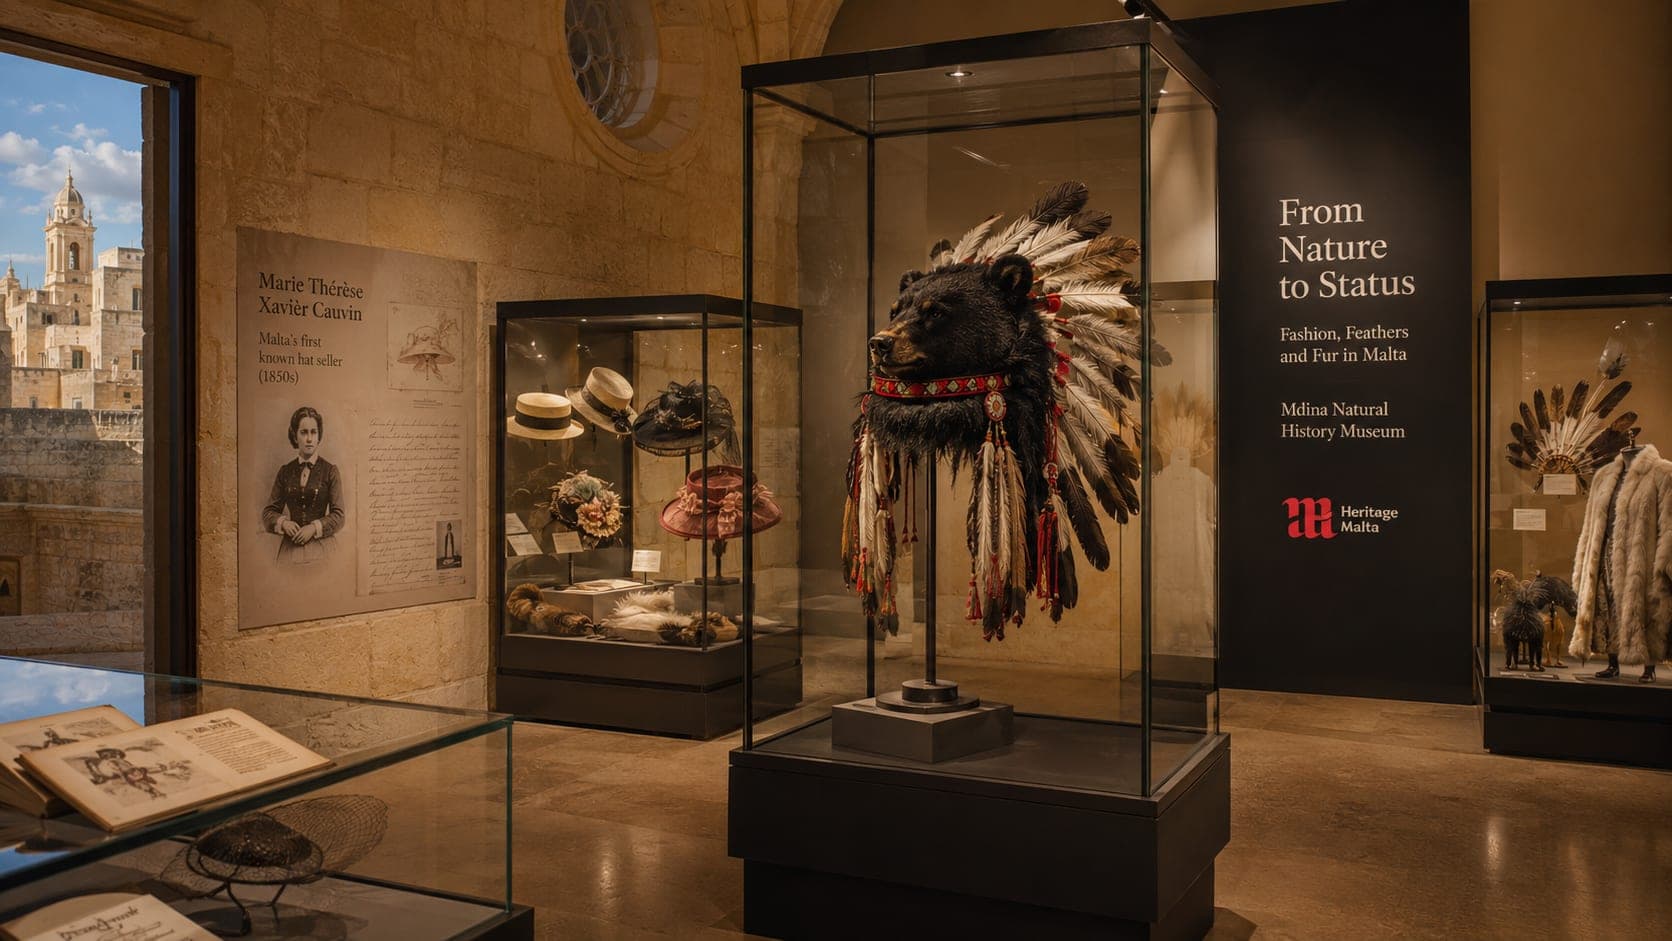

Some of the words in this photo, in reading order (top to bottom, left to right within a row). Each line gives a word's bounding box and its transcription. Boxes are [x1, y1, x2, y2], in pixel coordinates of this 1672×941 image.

[1279, 198, 1364, 226] From
[1279, 235, 1388, 263] Nature
[258, 271, 304, 293] Marie
[307, 277, 364, 299] Thérèse
[1279, 275, 1310, 300] to
[1319, 270, 1416, 298] Status
[258, 295, 309, 317] Xavièr
[312, 301, 362, 321] Cauvin
[258, 331, 298, 346] Malta's
[301, 334, 322, 348] first
[1280, 326, 1341, 343] Fashion,
[1346, 324, 1409, 340] Feathers
[258, 350, 295, 365] known
[297, 352, 314, 366] hat
[316, 353, 343, 367] seller
[1280, 348, 1308, 363] and
[1313, 347, 1339, 363] Fur
[1343, 347, 1358, 362] in
[1362, 346, 1408, 362] Malta
[258, 369, 299, 386] (1850s)
[1280, 402, 1328, 417] Mdina
[1332, 401, 1389, 417] Natural
[1280, 423, 1337, 442] History
[1340, 423, 1406, 439] Museum
[1340, 505, 1399, 521] Heritage
[1340, 521, 1380, 534] Malta
